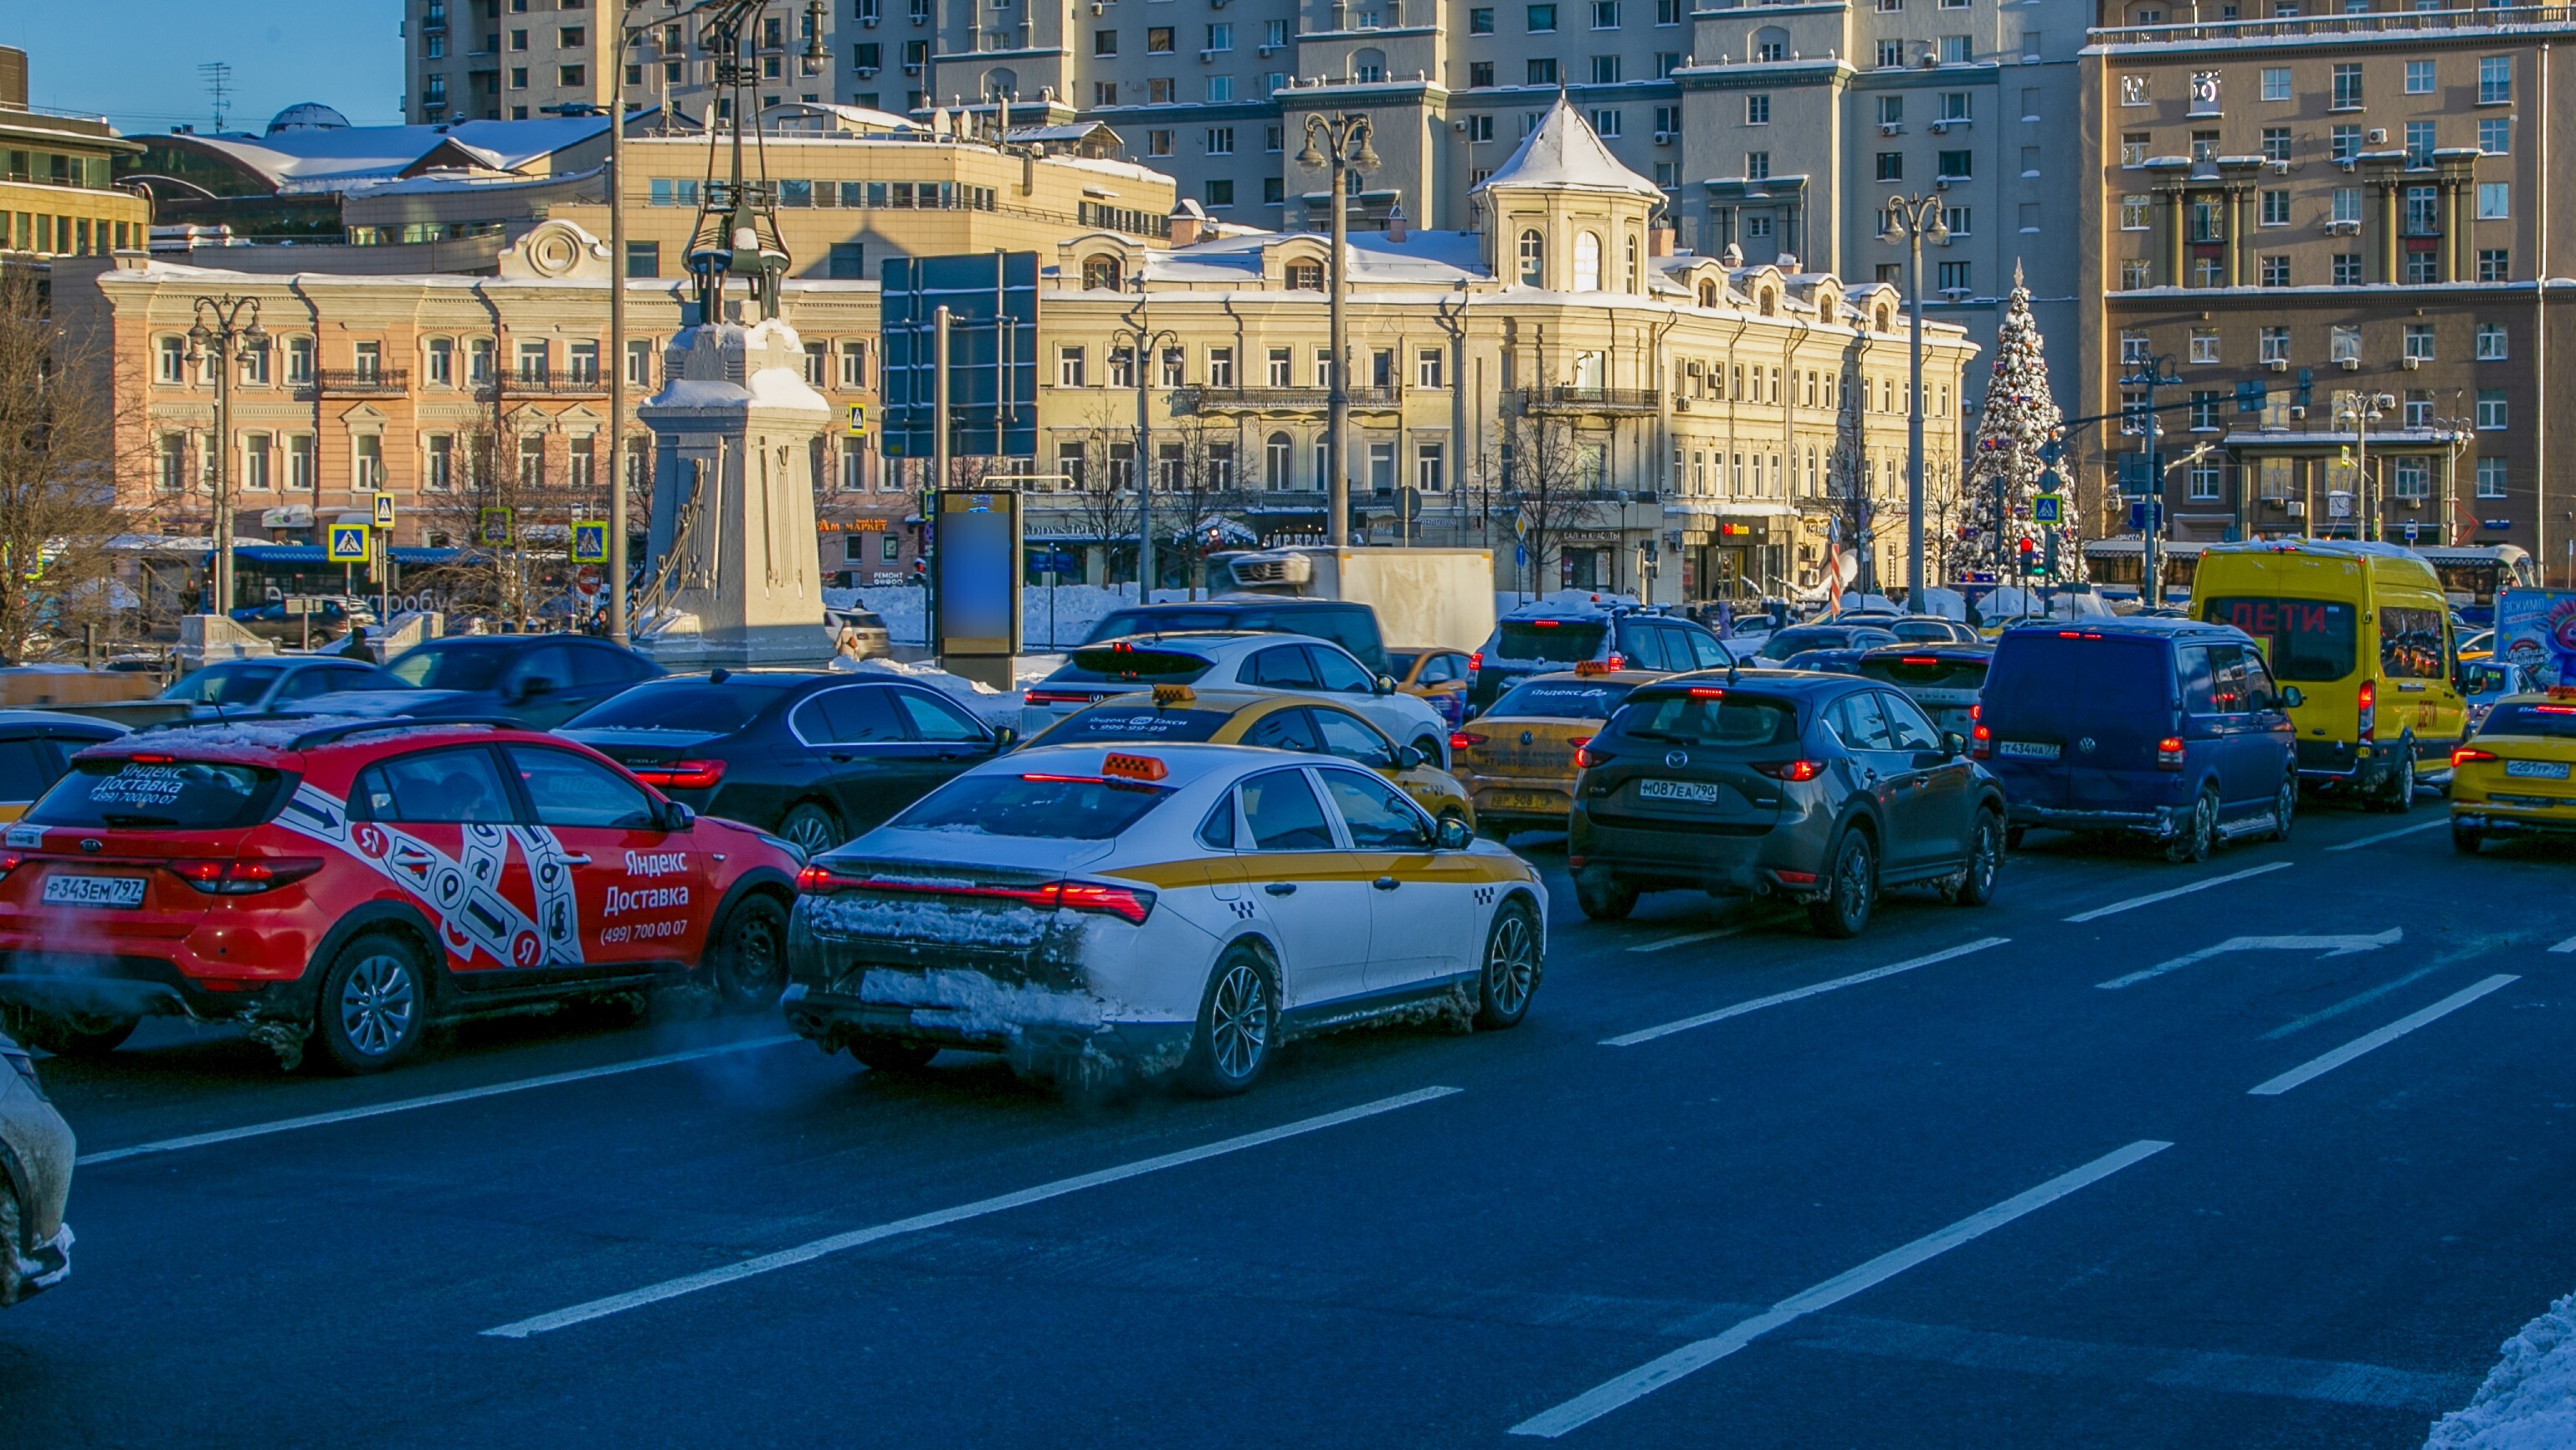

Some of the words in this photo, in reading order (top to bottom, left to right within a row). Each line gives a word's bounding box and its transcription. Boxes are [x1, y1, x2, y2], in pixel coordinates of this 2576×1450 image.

[1024, 526, 1066, 536] ADDY'S
[1563, 532, 1587, 540] САЛН
[2503, 598, 2545, 614] ЭСКИМО
[2231, 603, 2326, 633] ДЕТИ
[2416, 700, 2438, 732] ДЕТИ
[118, 763, 187, 779] Яндекс
[91, 775, 184, 794] Доставка
[361, 828, 379, 852] Я
[625, 851, 687, 877] Яндекс
[113, 880, 140, 896] 797
[603, 886, 689, 918] Доставка
[600, 926, 631, 946] (499)
[634, 924, 655, 939] 700
[657, 922, 671, 937] 00
[673, 919, 688, 935] 07
